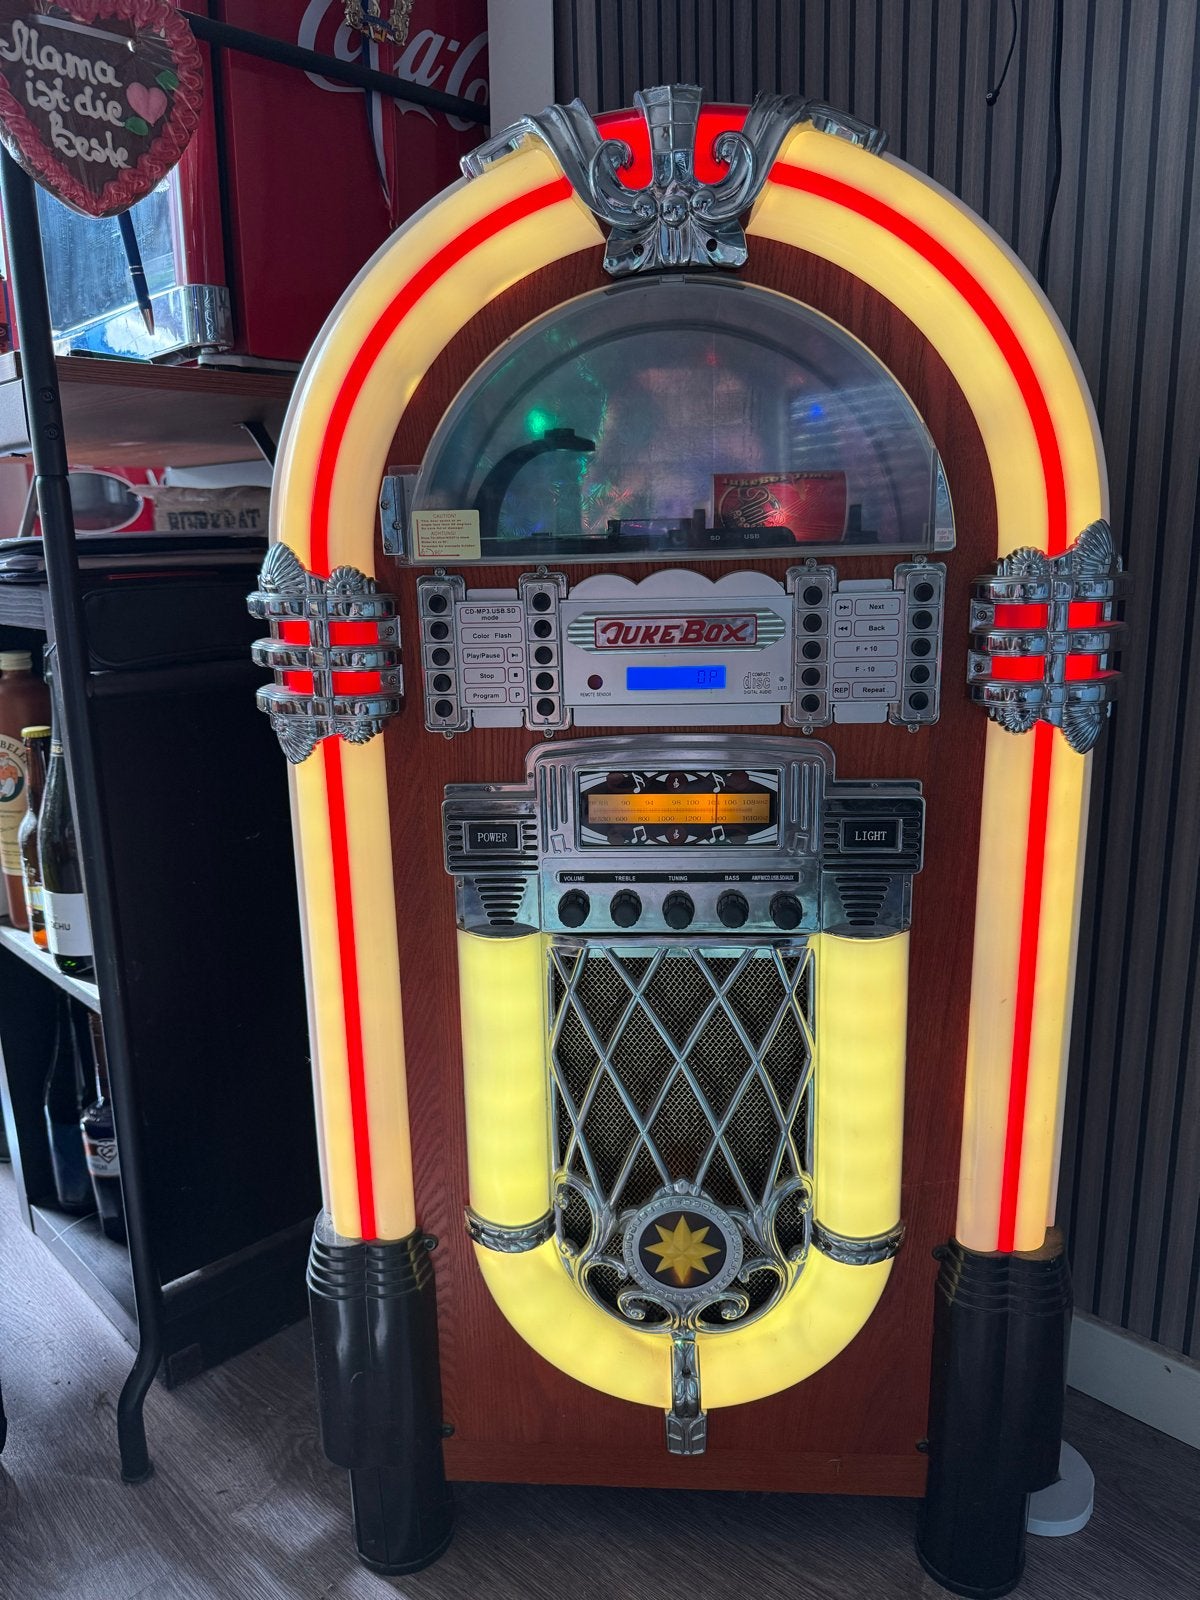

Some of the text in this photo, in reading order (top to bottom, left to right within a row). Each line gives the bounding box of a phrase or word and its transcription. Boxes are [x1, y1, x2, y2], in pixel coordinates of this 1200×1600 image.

[0, 20, 123, 87] Mama
[25, 69, 126, 127] ist die
[862, 686, 885, 694] Repeat
[477, 832, 508, 843] POWER
[854, 830, 887, 841] LIGHT
